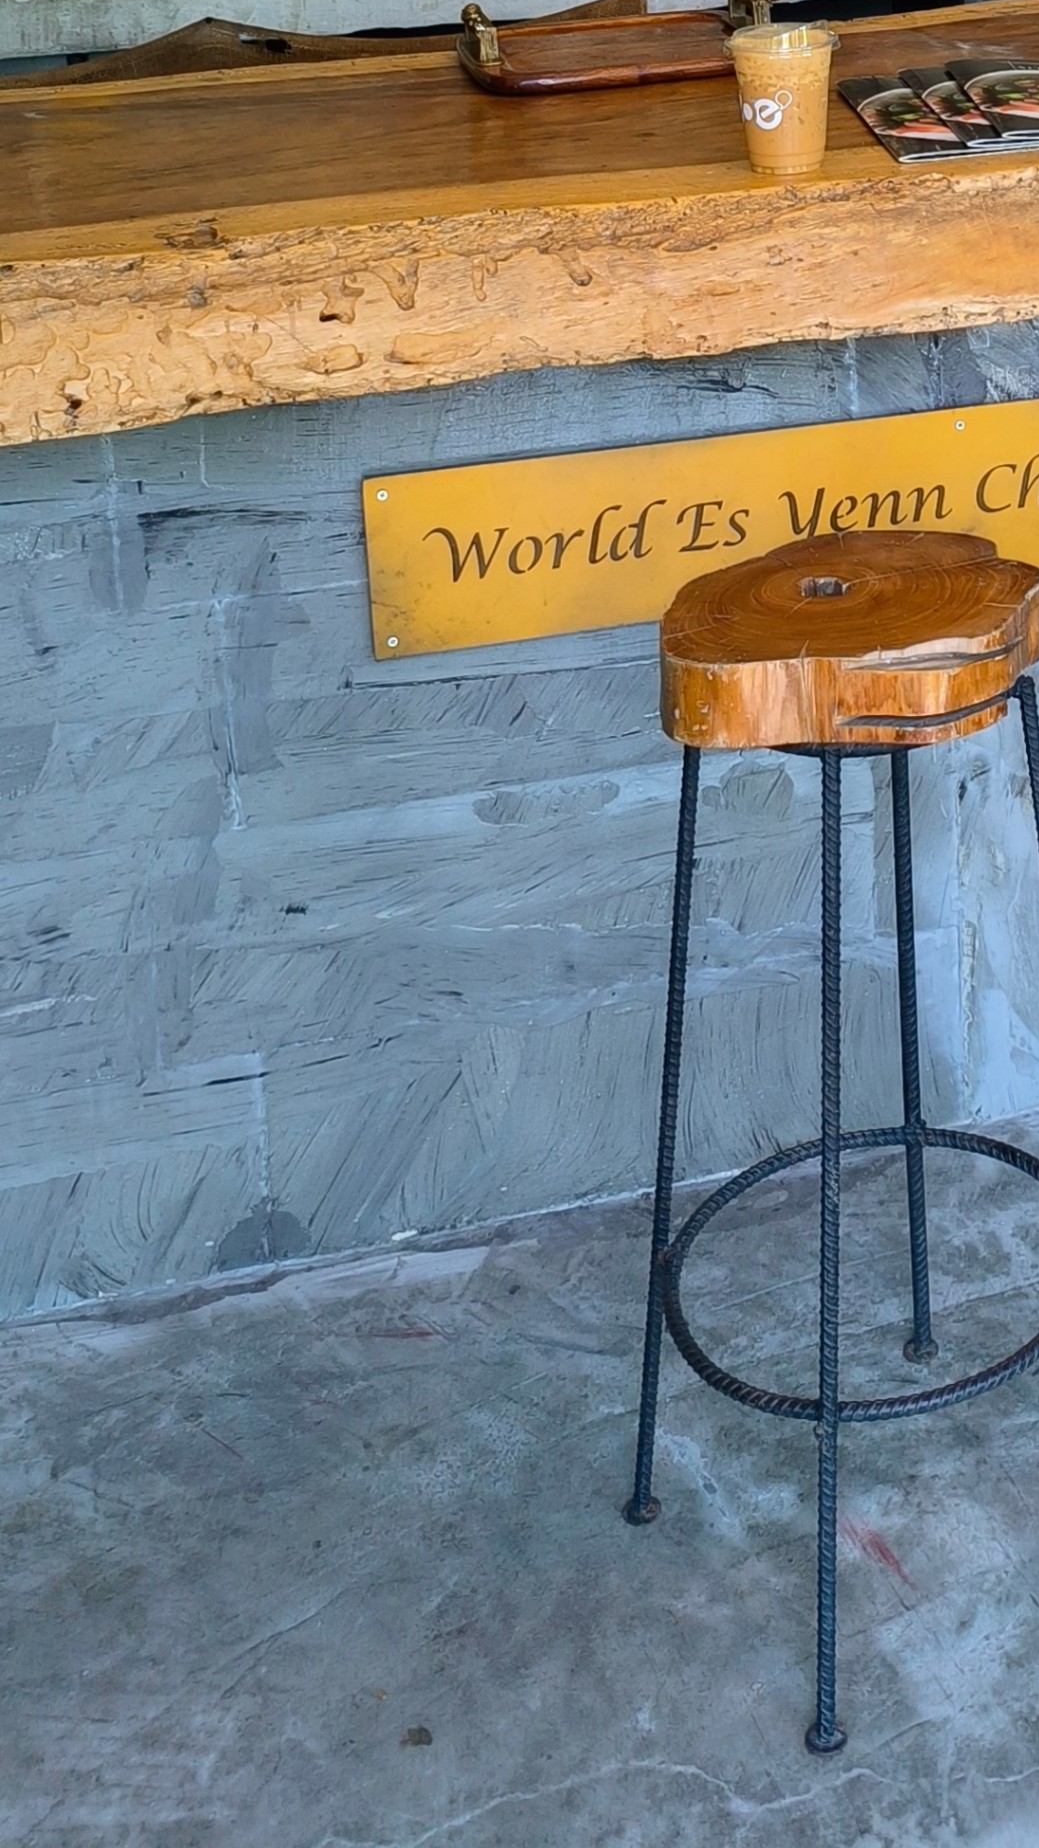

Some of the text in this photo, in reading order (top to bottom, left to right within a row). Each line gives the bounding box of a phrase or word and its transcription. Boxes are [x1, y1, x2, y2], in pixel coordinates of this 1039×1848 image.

[421, 498, 668, 584] World
[676, 499, 751, 553] Es
[777, 483, 953, 540] Yenn
